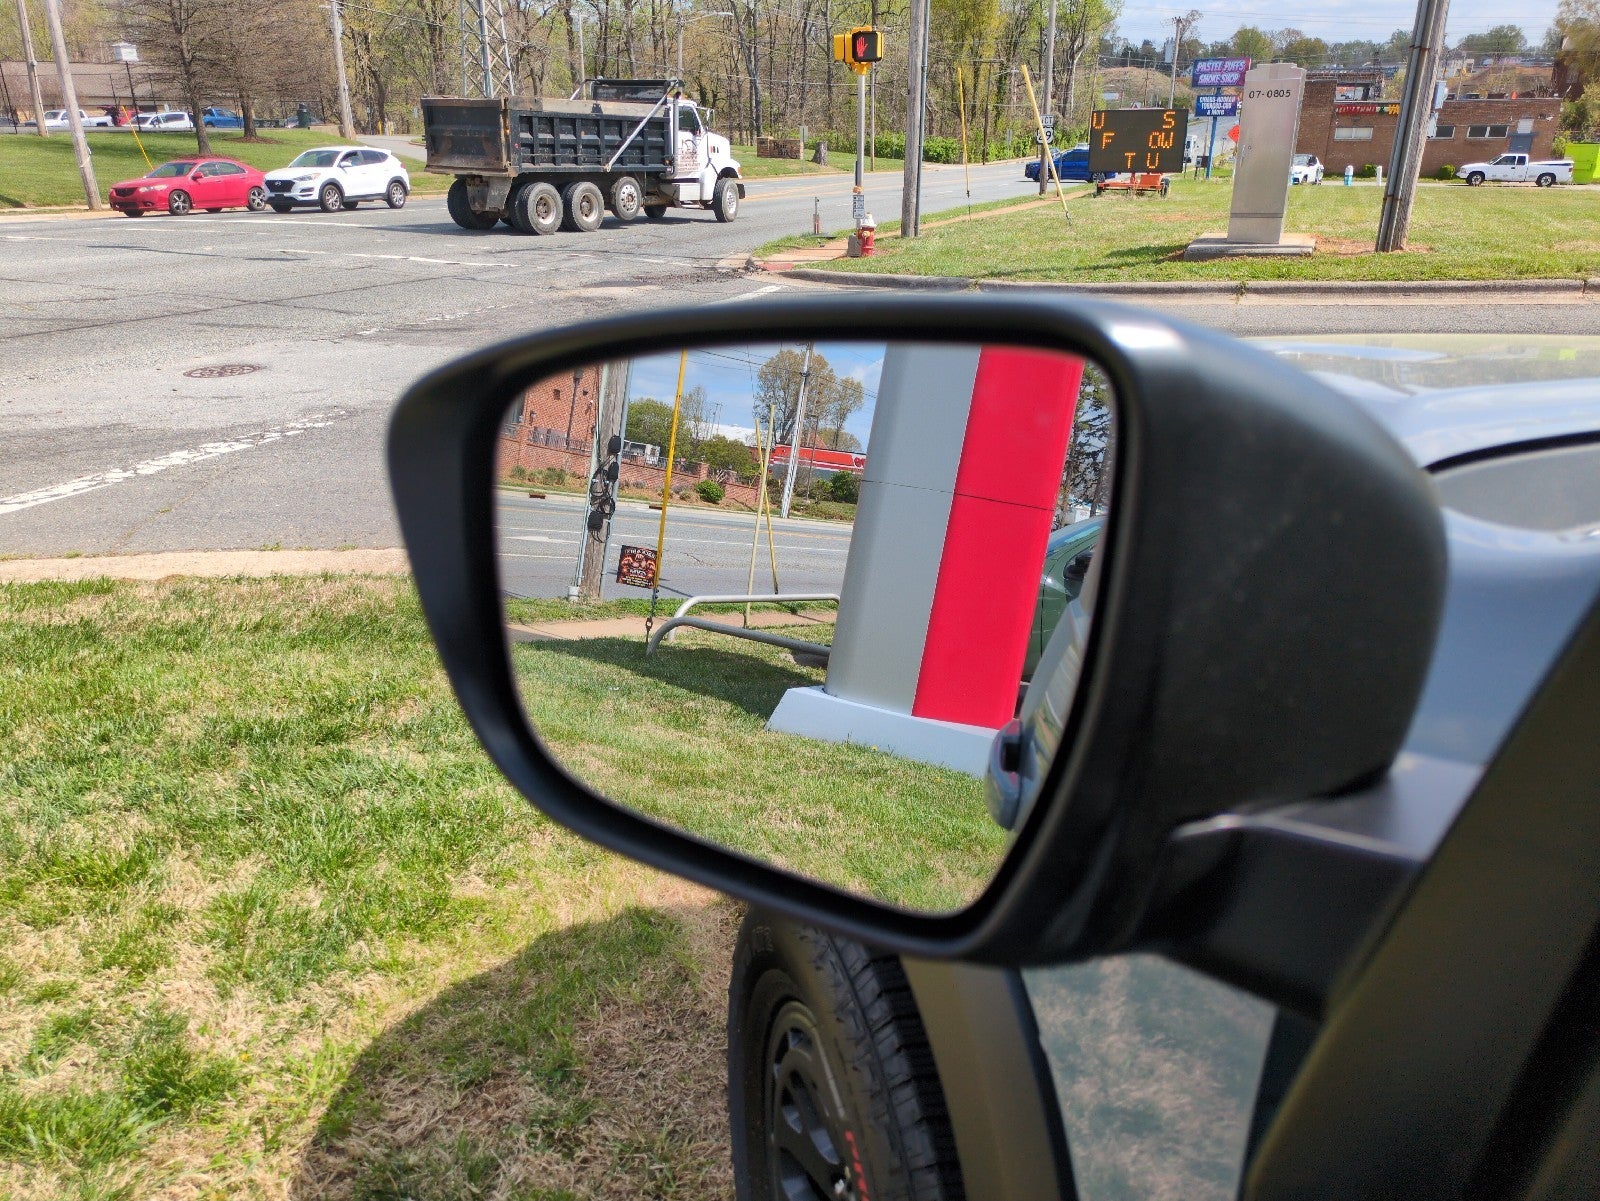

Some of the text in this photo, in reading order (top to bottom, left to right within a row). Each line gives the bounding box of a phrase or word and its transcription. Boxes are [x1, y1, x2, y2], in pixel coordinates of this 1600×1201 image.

[1196, 60, 1222, 72] PASTEL
[1198, 72, 1240, 85] SMOKE SHOP
[1248, 89, 1291, 99] 07-0805
[1092, 111, 1176, 129] U S
[1101, 132, 1116, 150] F
[1124, 152, 1160, 169] T U
